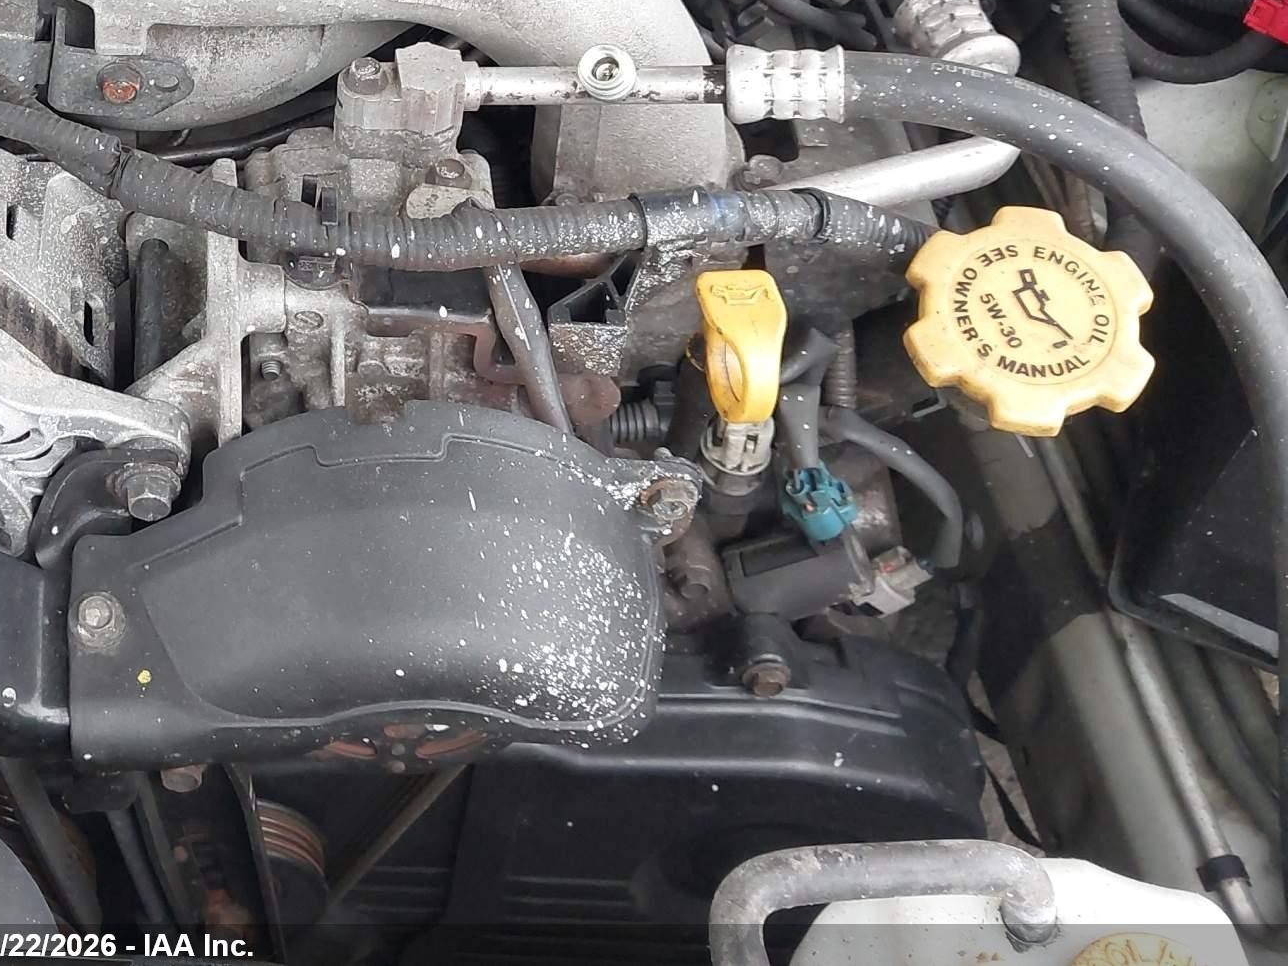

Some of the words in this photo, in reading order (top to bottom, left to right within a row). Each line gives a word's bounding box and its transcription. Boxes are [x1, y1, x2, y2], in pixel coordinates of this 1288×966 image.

[976, 244, 1019, 267] SEE
[953, 267, 993, 359] OWNER'S
[980, 292, 1022, 349] 5W-30
[1033, 246, 1107, 306] ENGINE
[1087, 314, 1110, 344] OIL
[997, 354, 1090, 378] MANUAL
